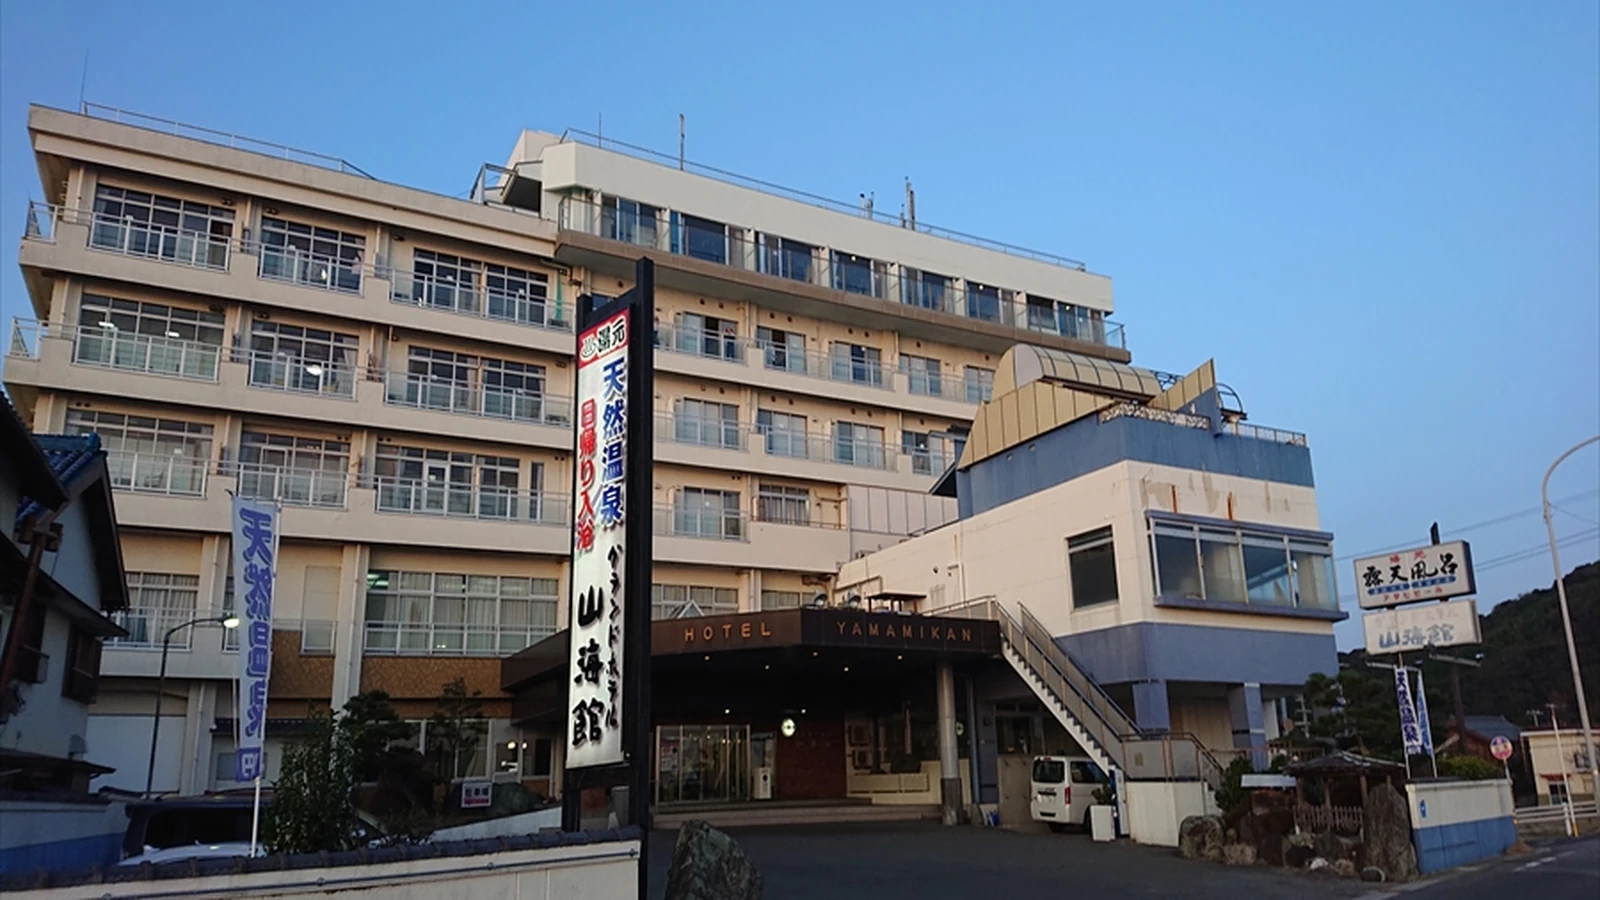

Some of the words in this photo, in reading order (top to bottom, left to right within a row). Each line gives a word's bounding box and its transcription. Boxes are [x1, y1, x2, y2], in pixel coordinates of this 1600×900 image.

[574, 399, 594, 550] 日帰り入浴
[602, 357, 625, 525] 天然温泉
[606, 543, 623, 728] グランドホテル
[684, 622, 771, 642] HOTEL
[836, 621, 972, 642] YAMAMIKAN
[1362, 552, 1459, 588] 露天風呂
[1378, 623, 1455, 649] 山海館
[571, 584, 605, 747] 山海館
